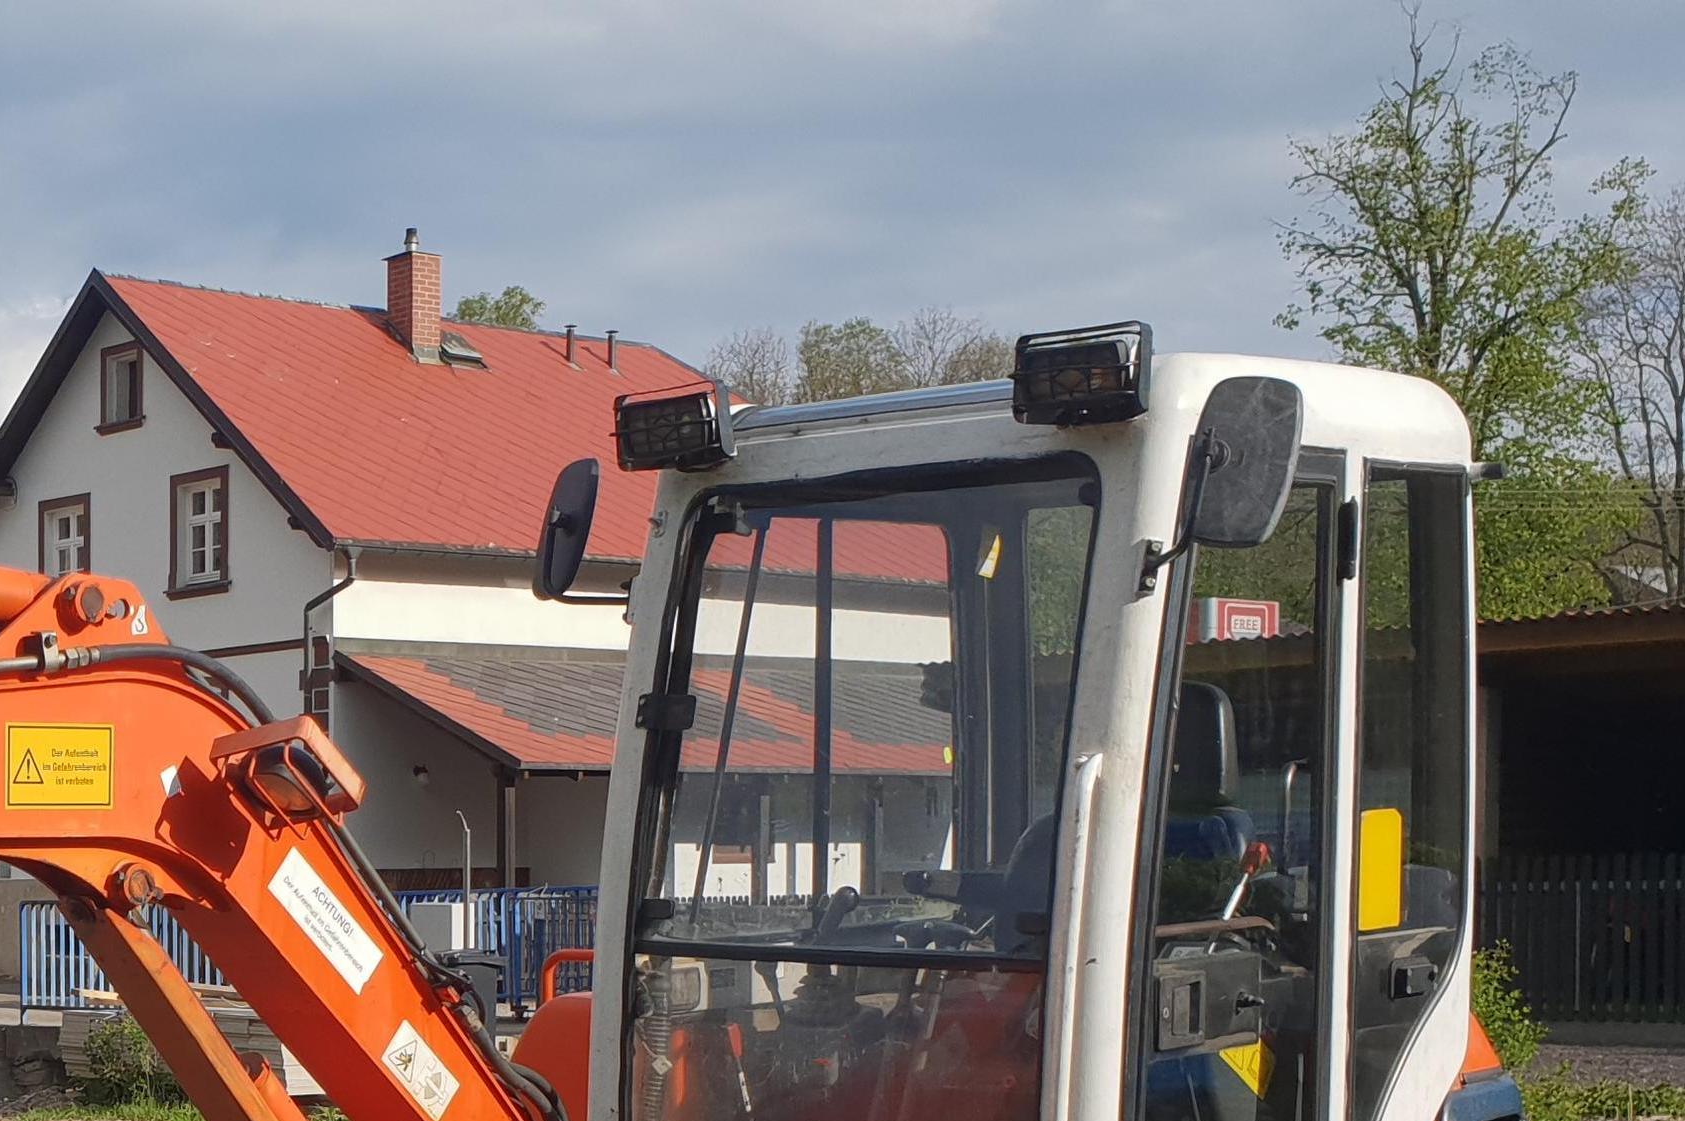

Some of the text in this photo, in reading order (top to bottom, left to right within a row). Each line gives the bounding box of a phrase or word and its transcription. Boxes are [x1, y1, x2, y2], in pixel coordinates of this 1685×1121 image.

[1233, 619, 1258, 630] FREE
[52, 749, 62, 757] Der
[66, 777, 94, 785] verboten
[312, 887, 356, 937] ACHTUNG!
